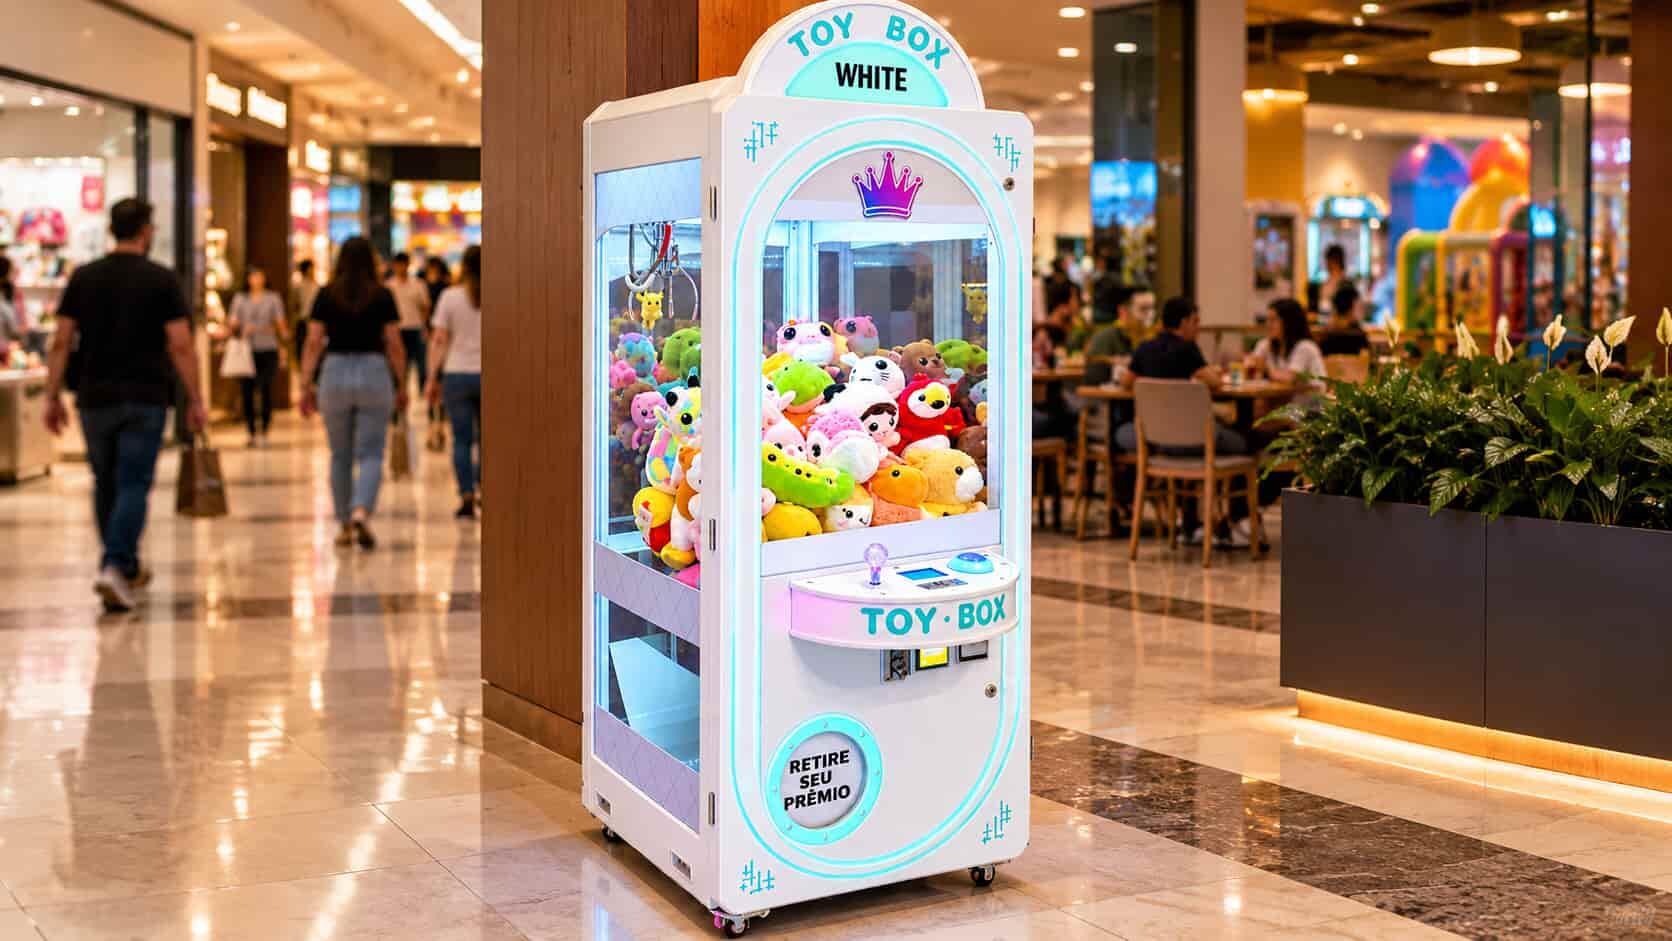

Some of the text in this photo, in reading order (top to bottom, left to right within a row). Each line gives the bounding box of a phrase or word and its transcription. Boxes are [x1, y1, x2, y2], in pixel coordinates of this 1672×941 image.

[787, 11, 951, 70] TOY BOX
[835, 62, 908, 92] WHITE
[860, 607, 937, 636] TOY
[957, 594, 1006, 630] BOX
[789, 749, 850, 775] RETIRE
[799, 770, 832, 790] SEU
